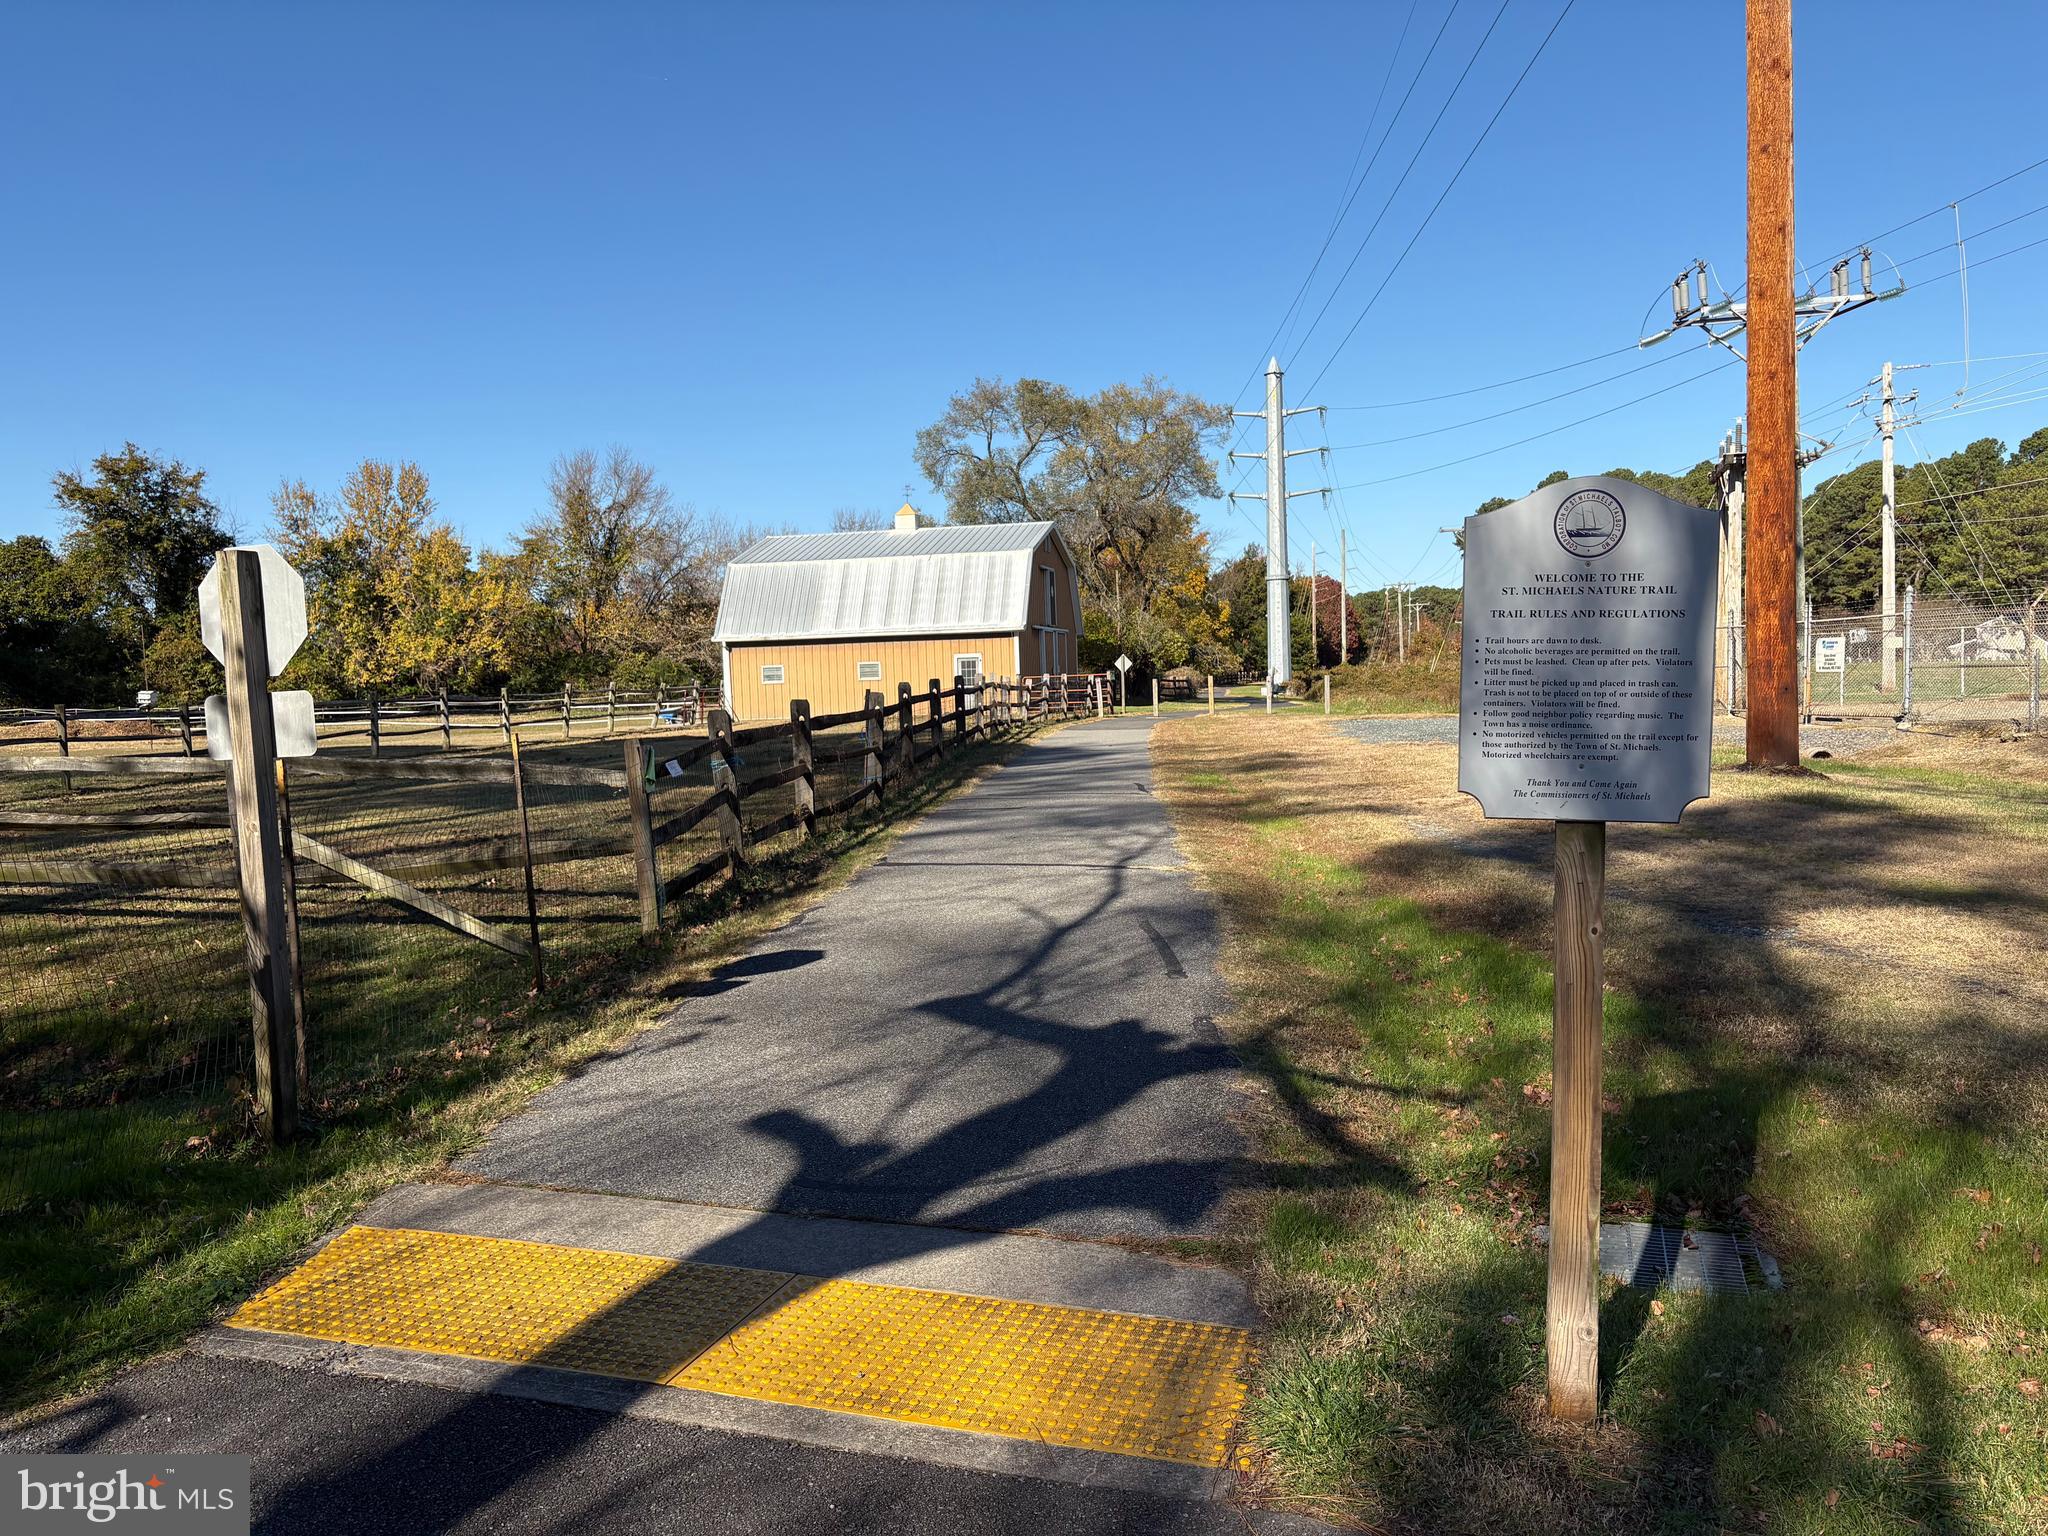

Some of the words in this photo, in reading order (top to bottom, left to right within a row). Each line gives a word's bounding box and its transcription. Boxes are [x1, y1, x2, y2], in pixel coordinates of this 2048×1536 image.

[1557, 512, 1578, 551] CORPORATION
[1578, 493, 1614, 507] MICHAELS
[1612, 506, 1622, 532] TALBOT
[1535, 573, 1596, 583] WELCOME
[1600, 573, 1617, 582] TO
[1620, 573, 1644, 582] THE
[1502, 587, 1519, 595] ST.
[1522, 586, 1584, 595] MICHAELS
[1588, 586, 1637, 595] NATURE
[1640, 586, 1677, 594] TRAIL
[1490, 610, 1526, 618] TRAIL
[1530, 610, 1567, 618] RULES
[1571, 610, 1596, 618] AND
[1599, 609, 1685, 618] REGULATIONS
[1485, 647, 1496, 655] No
[1497, 647, 1533, 655] alcoholic
[1534, 647, 1574, 656] beverages
[1591, 648, 1630, 657] permitted
[1502, 657, 1522, 665] must
[1535, 657, 1567, 665] leashed.
[1572, 658, 1595, 666] Clean
[1610, 657, 1630, 666] after
[1631, 659, 1650, 667] pets.
[1655, 658, 1693, 666] Violators
[1484, 668, 1498, 676] will
[1500, 668, 1510, 676] be
[1512, 668, 1534, 676] fined.
[1484, 678, 1507, 686] Litter
[1508, 677, 1528, 686] must
[1541, 679, 1568, 688] picked
[1569, 681, 1580, 689] up
[1582, 679, 1598, 687] and
[1600, 680, 1626, 689] placed
[1542, 689, 1552, 697] be
[1553, 689, 1579, 699] placed
[1594, 691, 1607, 699] top
[1608, 690, 1618, 698] of
[1630, 690, 1659, 698] outside
[1661, 690, 1670, 698] of
[1672, 690, 1693, 698] these
[1531, 699, 1567, 707] Violators
[1569, 700, 1584, 708] will
[1586, 700, 1596, 708] be
[1597, 700, 1620, 708] fined.
[1483, 709, 1509, 717] Follow
[1511, 710, 1530, 719] good
[1532, 710, 1569, 720] neighbor
[1570, 710, 1593, 720] policy
[1596, 711, 1635, 720] regarding
[1668, 712, 1684, 720] The
[1529, 720, 1549, 728] noise
[1551, 721, 1593, 729] ordinance.
[1537, 731, 1568, 739] vehicles
[1570, 732, 1609, 741] permitted
[1623, 732, 1636, 740] the
[1638, 733, 1656, 741] trail
[1658, 734, 1684, 743] except
[1686, 734, 1699, 742] for
[1482, 740, 1502, 748] those
[1504, 741, 1546, 749] authorized
[1548, 741, 1558, 751] by
[1560, 741, 1573, 750] the
[1575, 742, 1597, 750] Town
[1599, 742, 1608, 750] of
[1623, 743, 1662, 751] Michaels.
[1482, 751, 1522, 759] Motorized
[1587, 754, 1618, 763] exempt.
[1527, 778, 1551, 787] Thank
[1555, 779, 1570, 787] You
[1571, 780, 1587, 788] and
[1589, 779, 1612, 789] Come
[1613, 780, 1637, 791] Again
[1513, 789, 1528, 798] The
[1530, 790, 1589, 799] Commissioners
[1591, 791, 1602, 801] of
[1601, 791, 1612, 800] St.
[1615, 792, 1651, 800] Michaels
